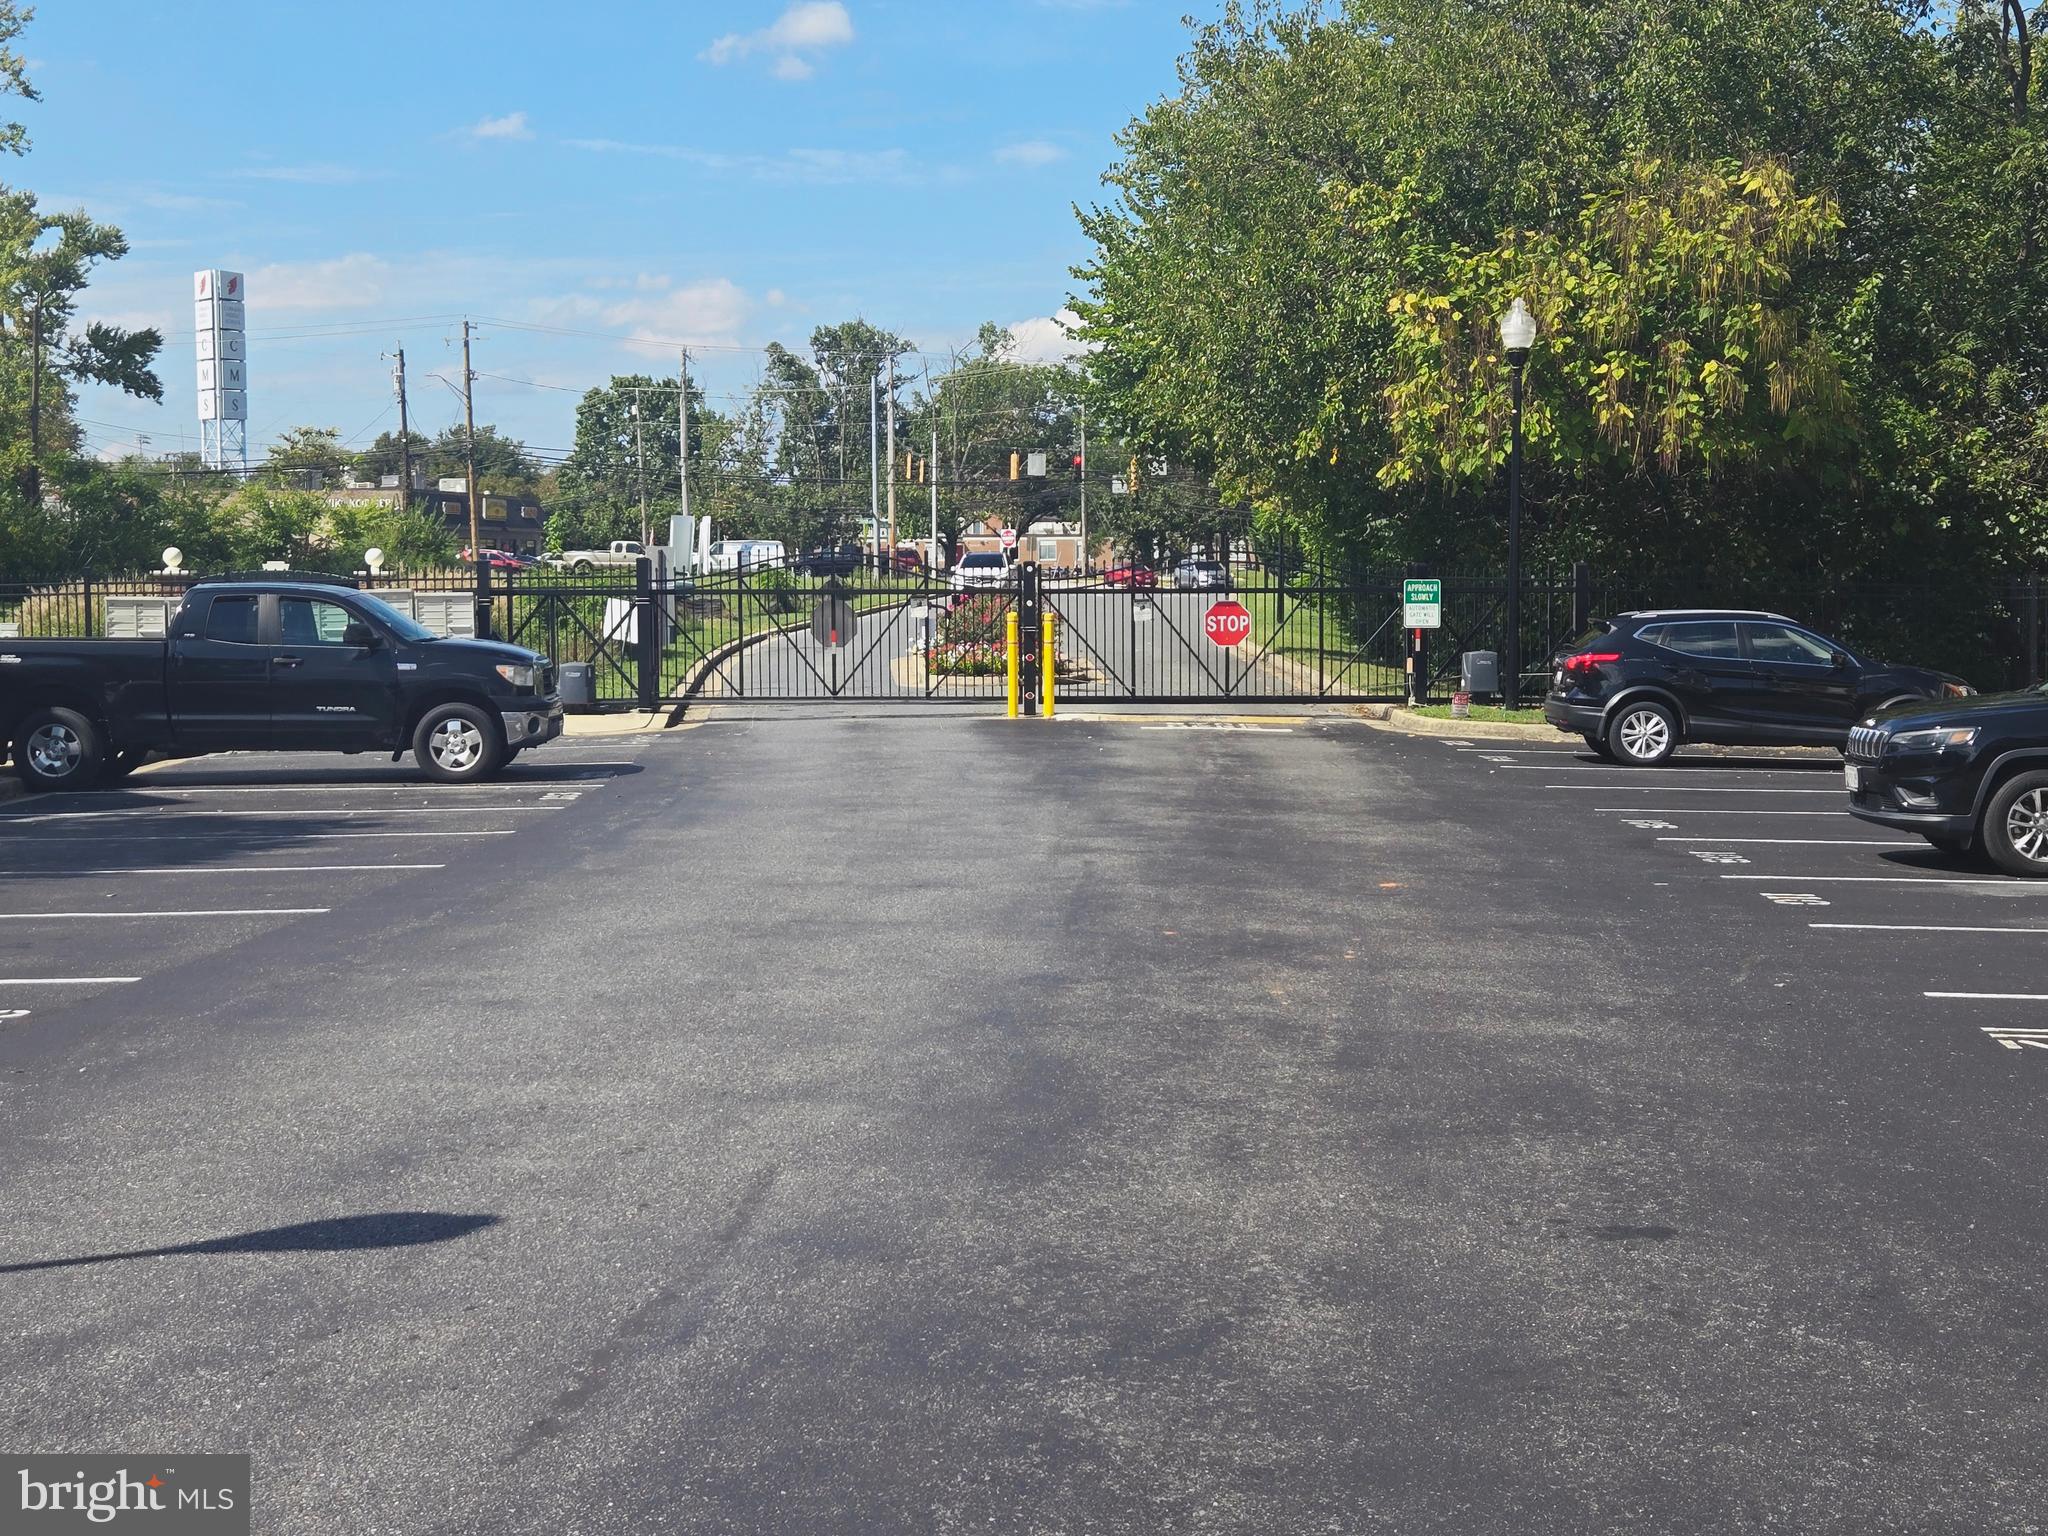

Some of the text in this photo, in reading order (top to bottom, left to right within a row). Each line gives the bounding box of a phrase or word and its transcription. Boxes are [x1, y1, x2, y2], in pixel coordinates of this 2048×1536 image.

[1407, 584, 1438, 592] APPROACH
[1410, 593, 1434, 601] SLOWLY
[1207, 615, 1249, 632] STOP
